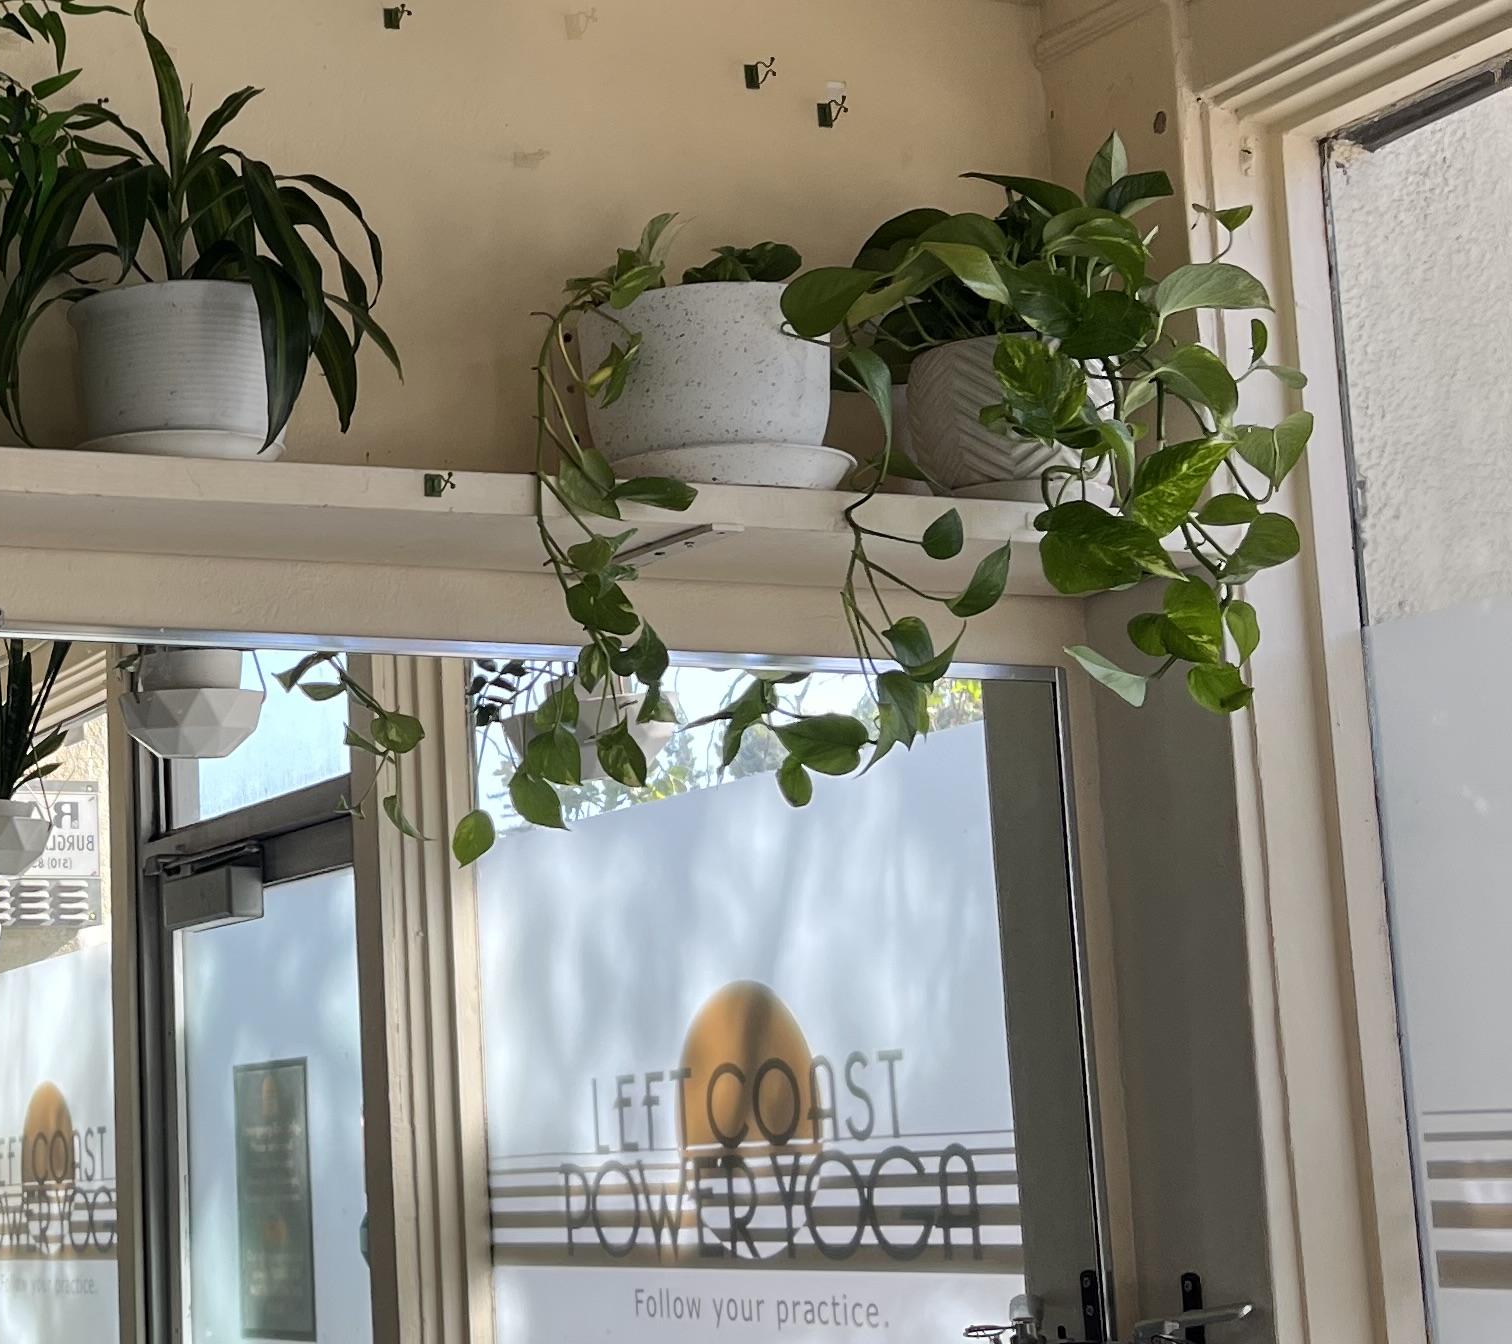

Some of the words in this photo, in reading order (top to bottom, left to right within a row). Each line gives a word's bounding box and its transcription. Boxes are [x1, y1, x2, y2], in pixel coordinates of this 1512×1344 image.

[592, 1067, 692, 1155] LEFT
[706, 1048, 903, 1149] COAST
[31, 1126, 107, 1185] COAST
[558, 1155, 761, 1261] POWER
[768, 1142, 984, 1262] YOGA
[634, 1287, 701, 1321] Follow
[712, 1296, 765, 1329] your
[777, 1293, 890, 1331] practice.
